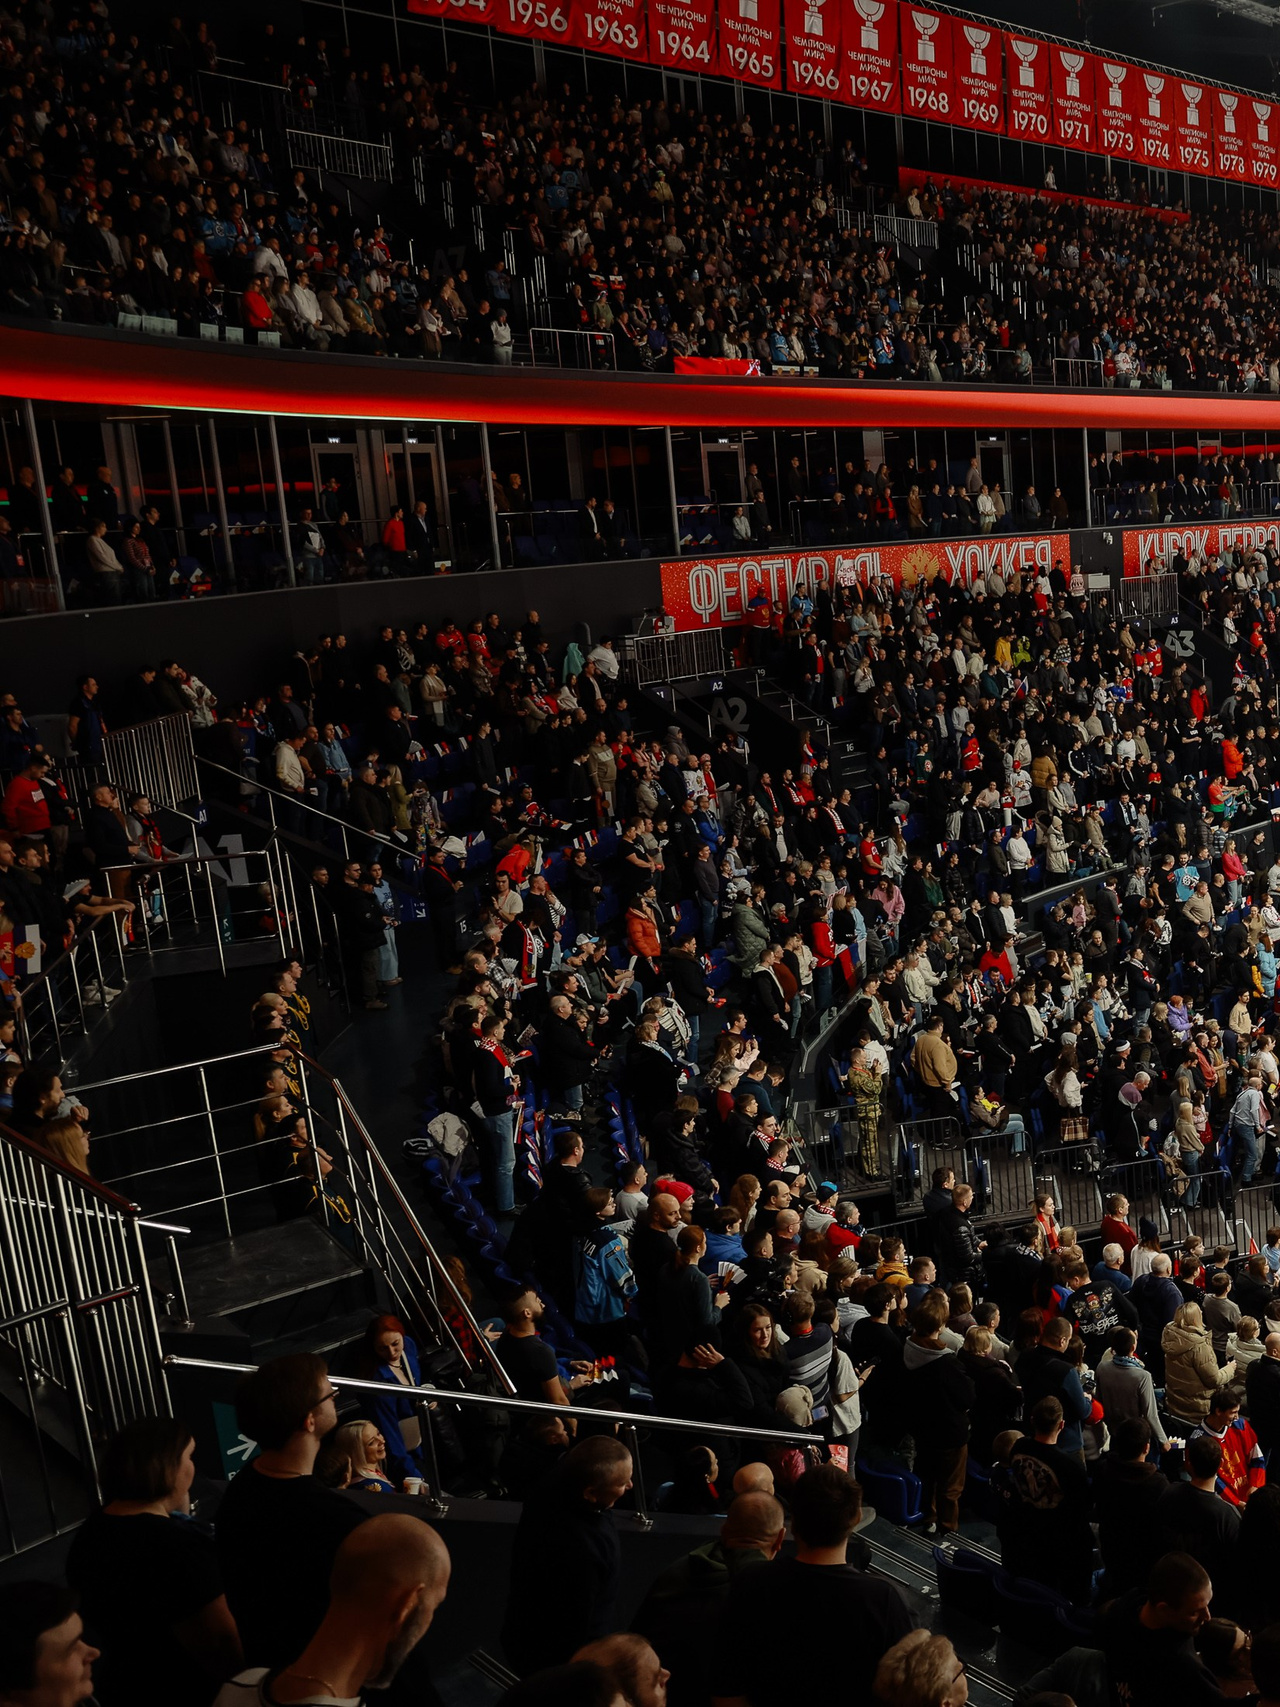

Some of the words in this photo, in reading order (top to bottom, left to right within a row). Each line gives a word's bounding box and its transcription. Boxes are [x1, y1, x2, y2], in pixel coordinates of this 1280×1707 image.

[507, 0, 568, 32] 1956
[597, 1, 623, 15] МИРА
[655, 3, 707, 23] ЧЕМПИОНЫ
[584, 13, 639, 49] 1963
[671, 17, 694, 31] МИРА
[724, 18, 772, 40] ЧЕМПИОНЫ
[657, 30, 711, 63] 1964
[738, 33, 761, 47] МИРА
[793, 36, 835, 54] ЧЕМПИОНЫ
[726, 43, 774, 77] 1965
[803, 48, 825, 60] МИРА
[848, 51, 891, 68] ЧЕМПИОНЫ
[792, 60, 839, 90] 1966
[860, 63, 881, 75] МИРА
[907, 63, 948, 79] ЧЕМПИОНЫ
[850, 75, 893, 102] 1967
[917, 75, 937, 86] МИРА
[961, 76, 997, 91] ЧЕМПИОНЫ
[908, 86, 949, 113] 1968
[971, 87, 989, 98] МИРА
[1012, 88, 1045, 102] ЧЕМПИОНЫ
[962, 98, 999, 124] 1969
[1057, 97, 1091, 112] ЧЕМПИОНЫ
[1101, 108, 1132, 121] ЧЕМПИОНЫ
[1013, 110, 1047, 134] 1970
[1059, 119, 1089, 143] 1971
[1103, 128, 1134, 152] 1973
[1142, 138, 1170, 161] 1974
[1179, 145, 1209, 168] 1975
[1219, 152, 1245, 174] 1978
[1252, 160, 1277, 181] 1979
[712, 681, 723, 692] A2
[459, 920, 467, 934] 15
